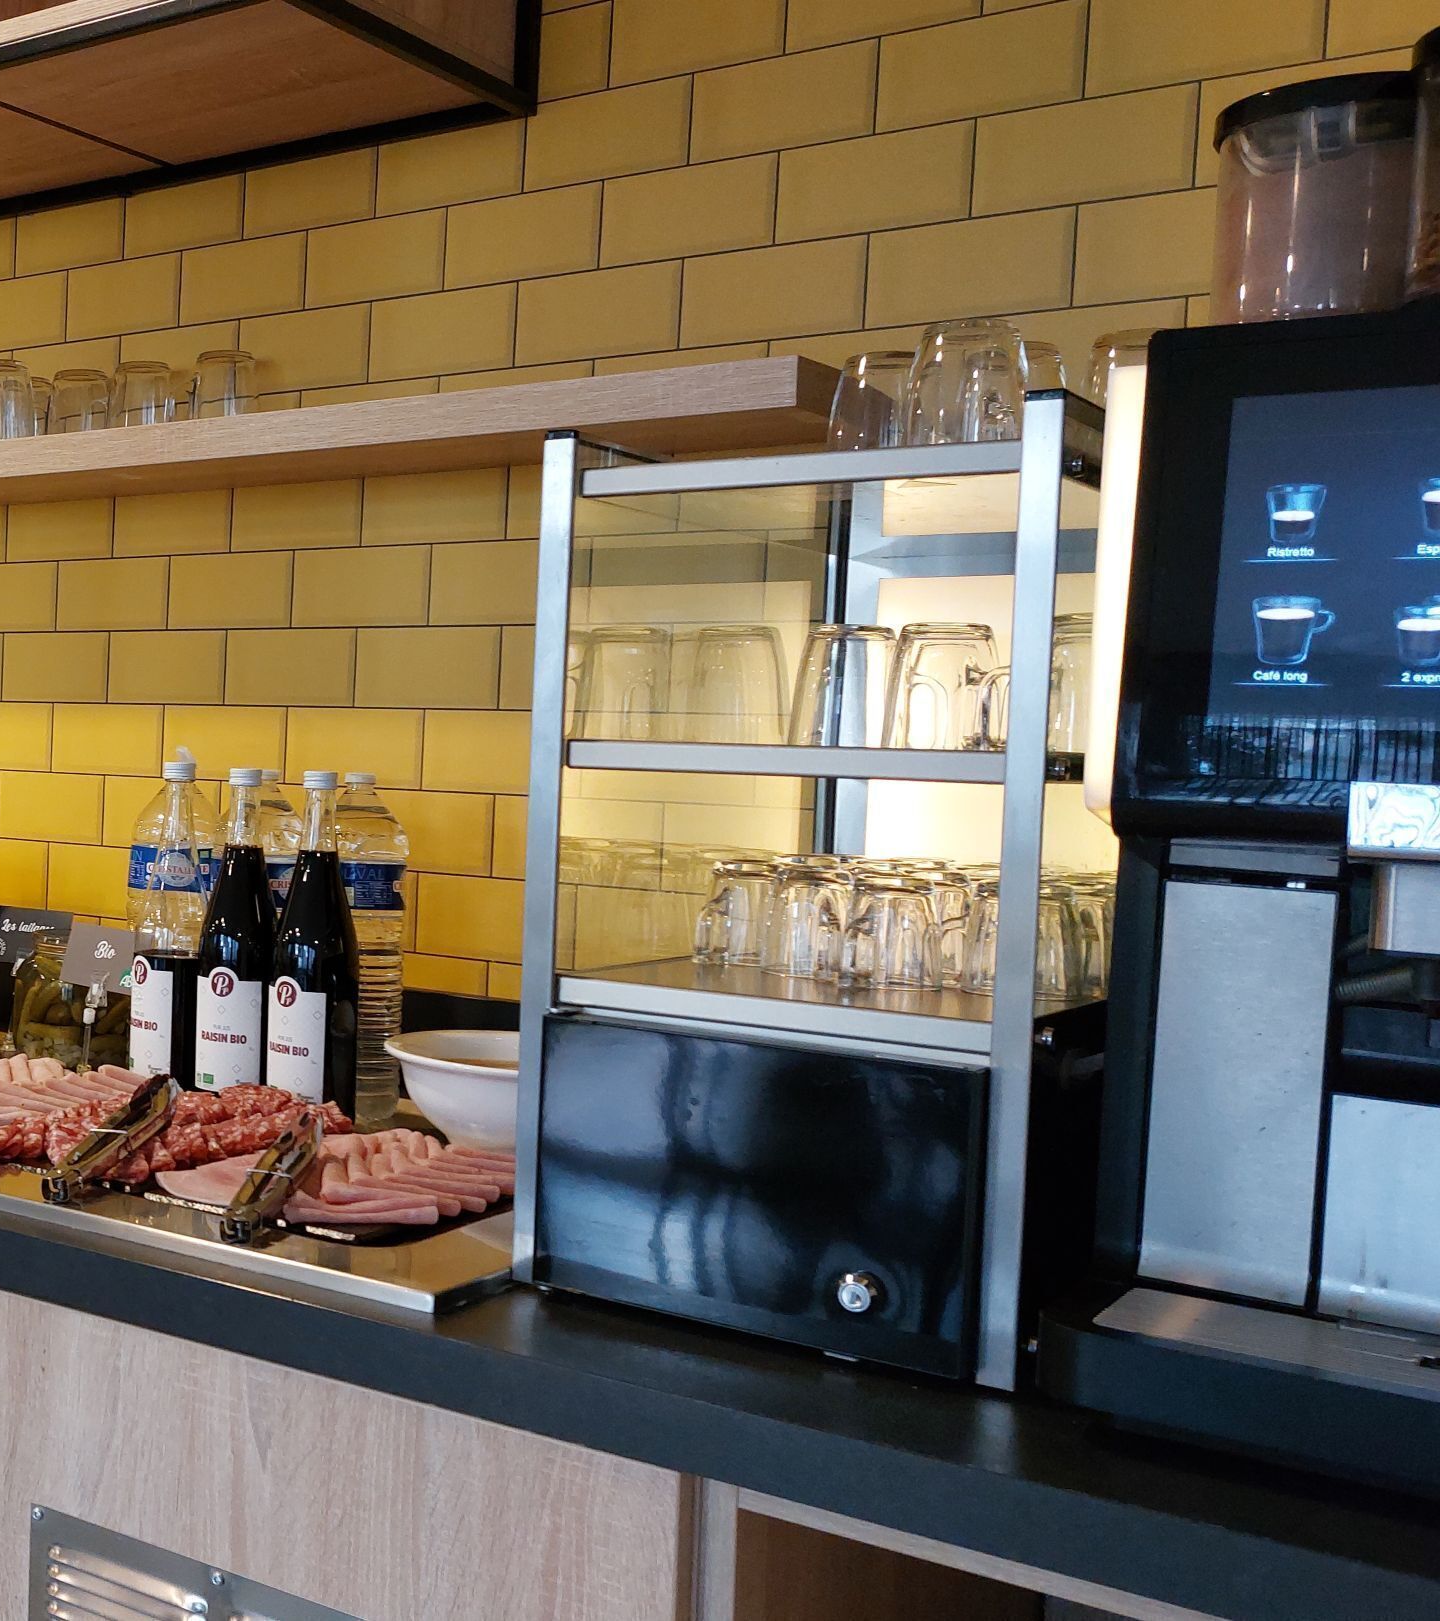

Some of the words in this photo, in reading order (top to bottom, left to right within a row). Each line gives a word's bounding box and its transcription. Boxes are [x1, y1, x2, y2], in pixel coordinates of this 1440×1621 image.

[1266, 546, 1315, 557] Ristretto
[1252, 670, 1281, 681] Café
[1283, 670, 1308, 683] long
[1401, 672, 1410, 682] 2
[149, 864, 209, 875] CRISTALIE
[1, 918, 16, 932] Les
[94, 940, 116, 959] Bio
[144, 1021, 158, 1032] BIO
[201, 1030, 228, 1044] RAISIN
[230, 1034, 247, 1045] BIO
[292, 1046, 309, 1057] BIO
